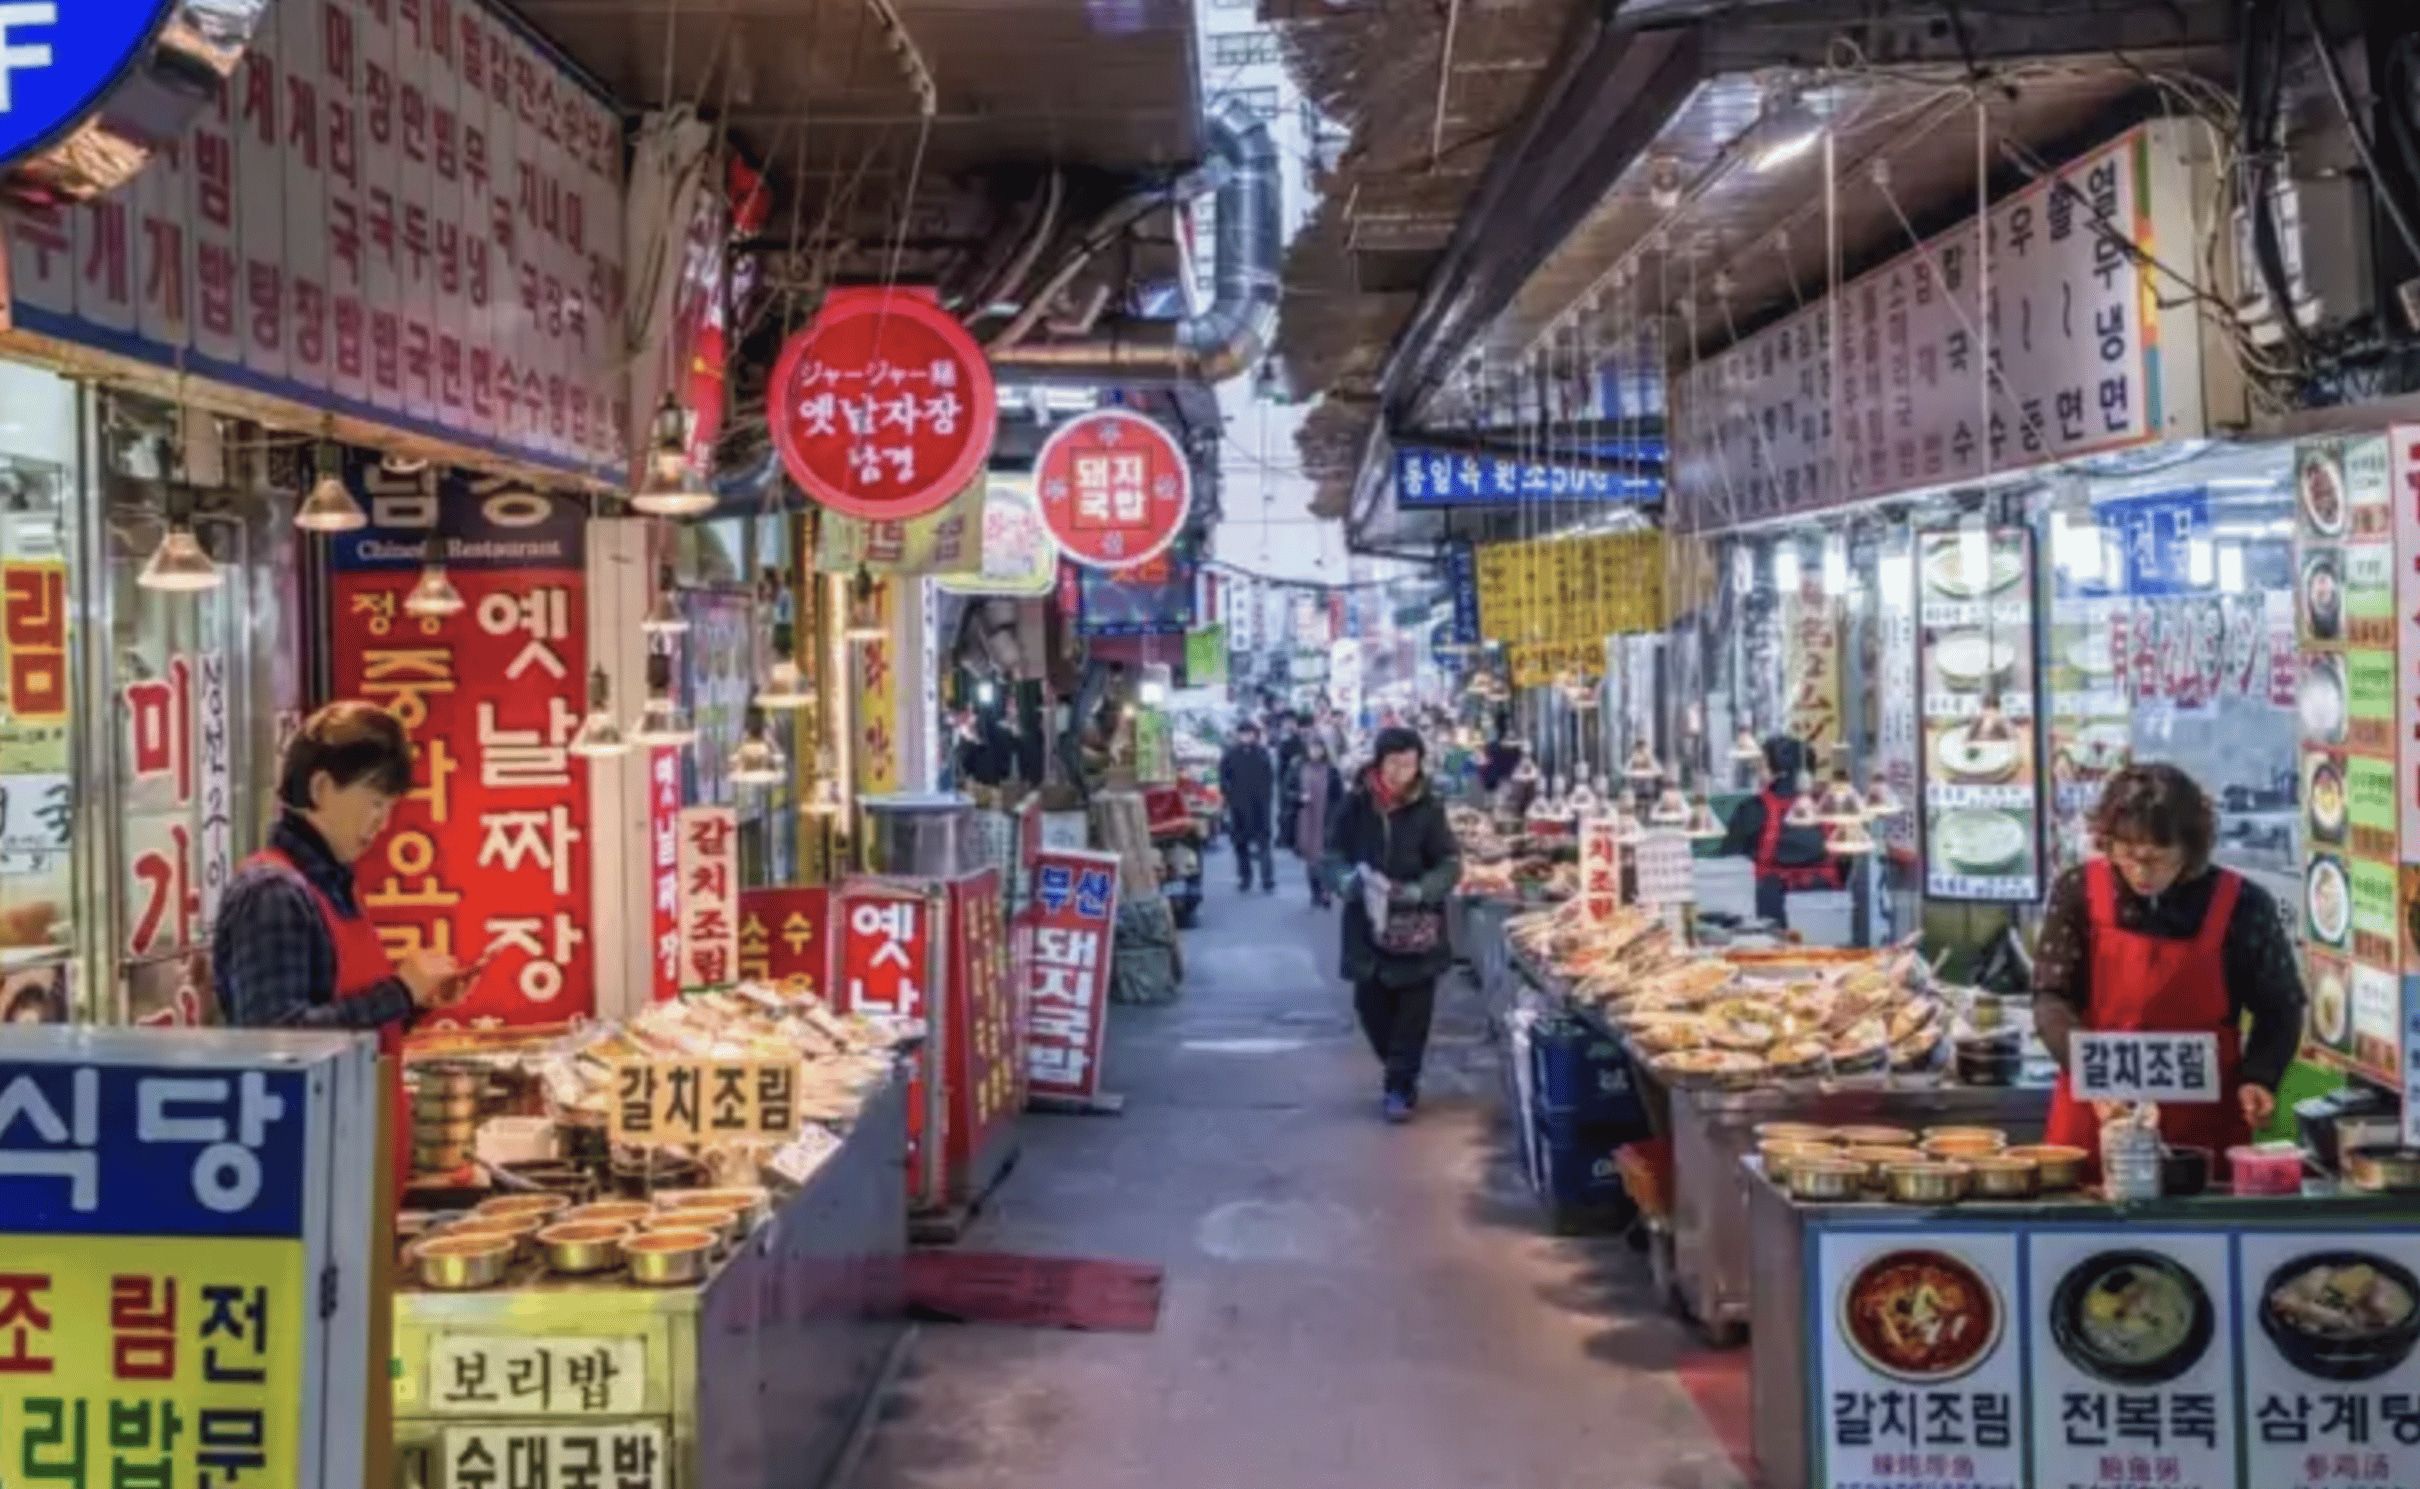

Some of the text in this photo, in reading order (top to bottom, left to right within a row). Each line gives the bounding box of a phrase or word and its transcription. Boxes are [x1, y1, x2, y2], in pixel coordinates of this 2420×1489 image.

[446, 538, 563, 559] Restaurant
[477, 586, 583, 1001] 옛날짜장
[690, 815, 735, 986] 갈치조림
[2082, 1041, 2206, 1090] 갈치조림
[619, 1065, 793, 1133] 갈치조림
[0, 1067, 284, 1212] 식당
[443, 1346, 620, 1410] 보리밥
[1832, 1391, 2012, 1447] 갈치조림
[2061, 1392, 2218, 1449] 전복죽
[2256, 1391, 2420, 1447] 삼계탕
[455, 1435, 658, 1489] 순대국밥
